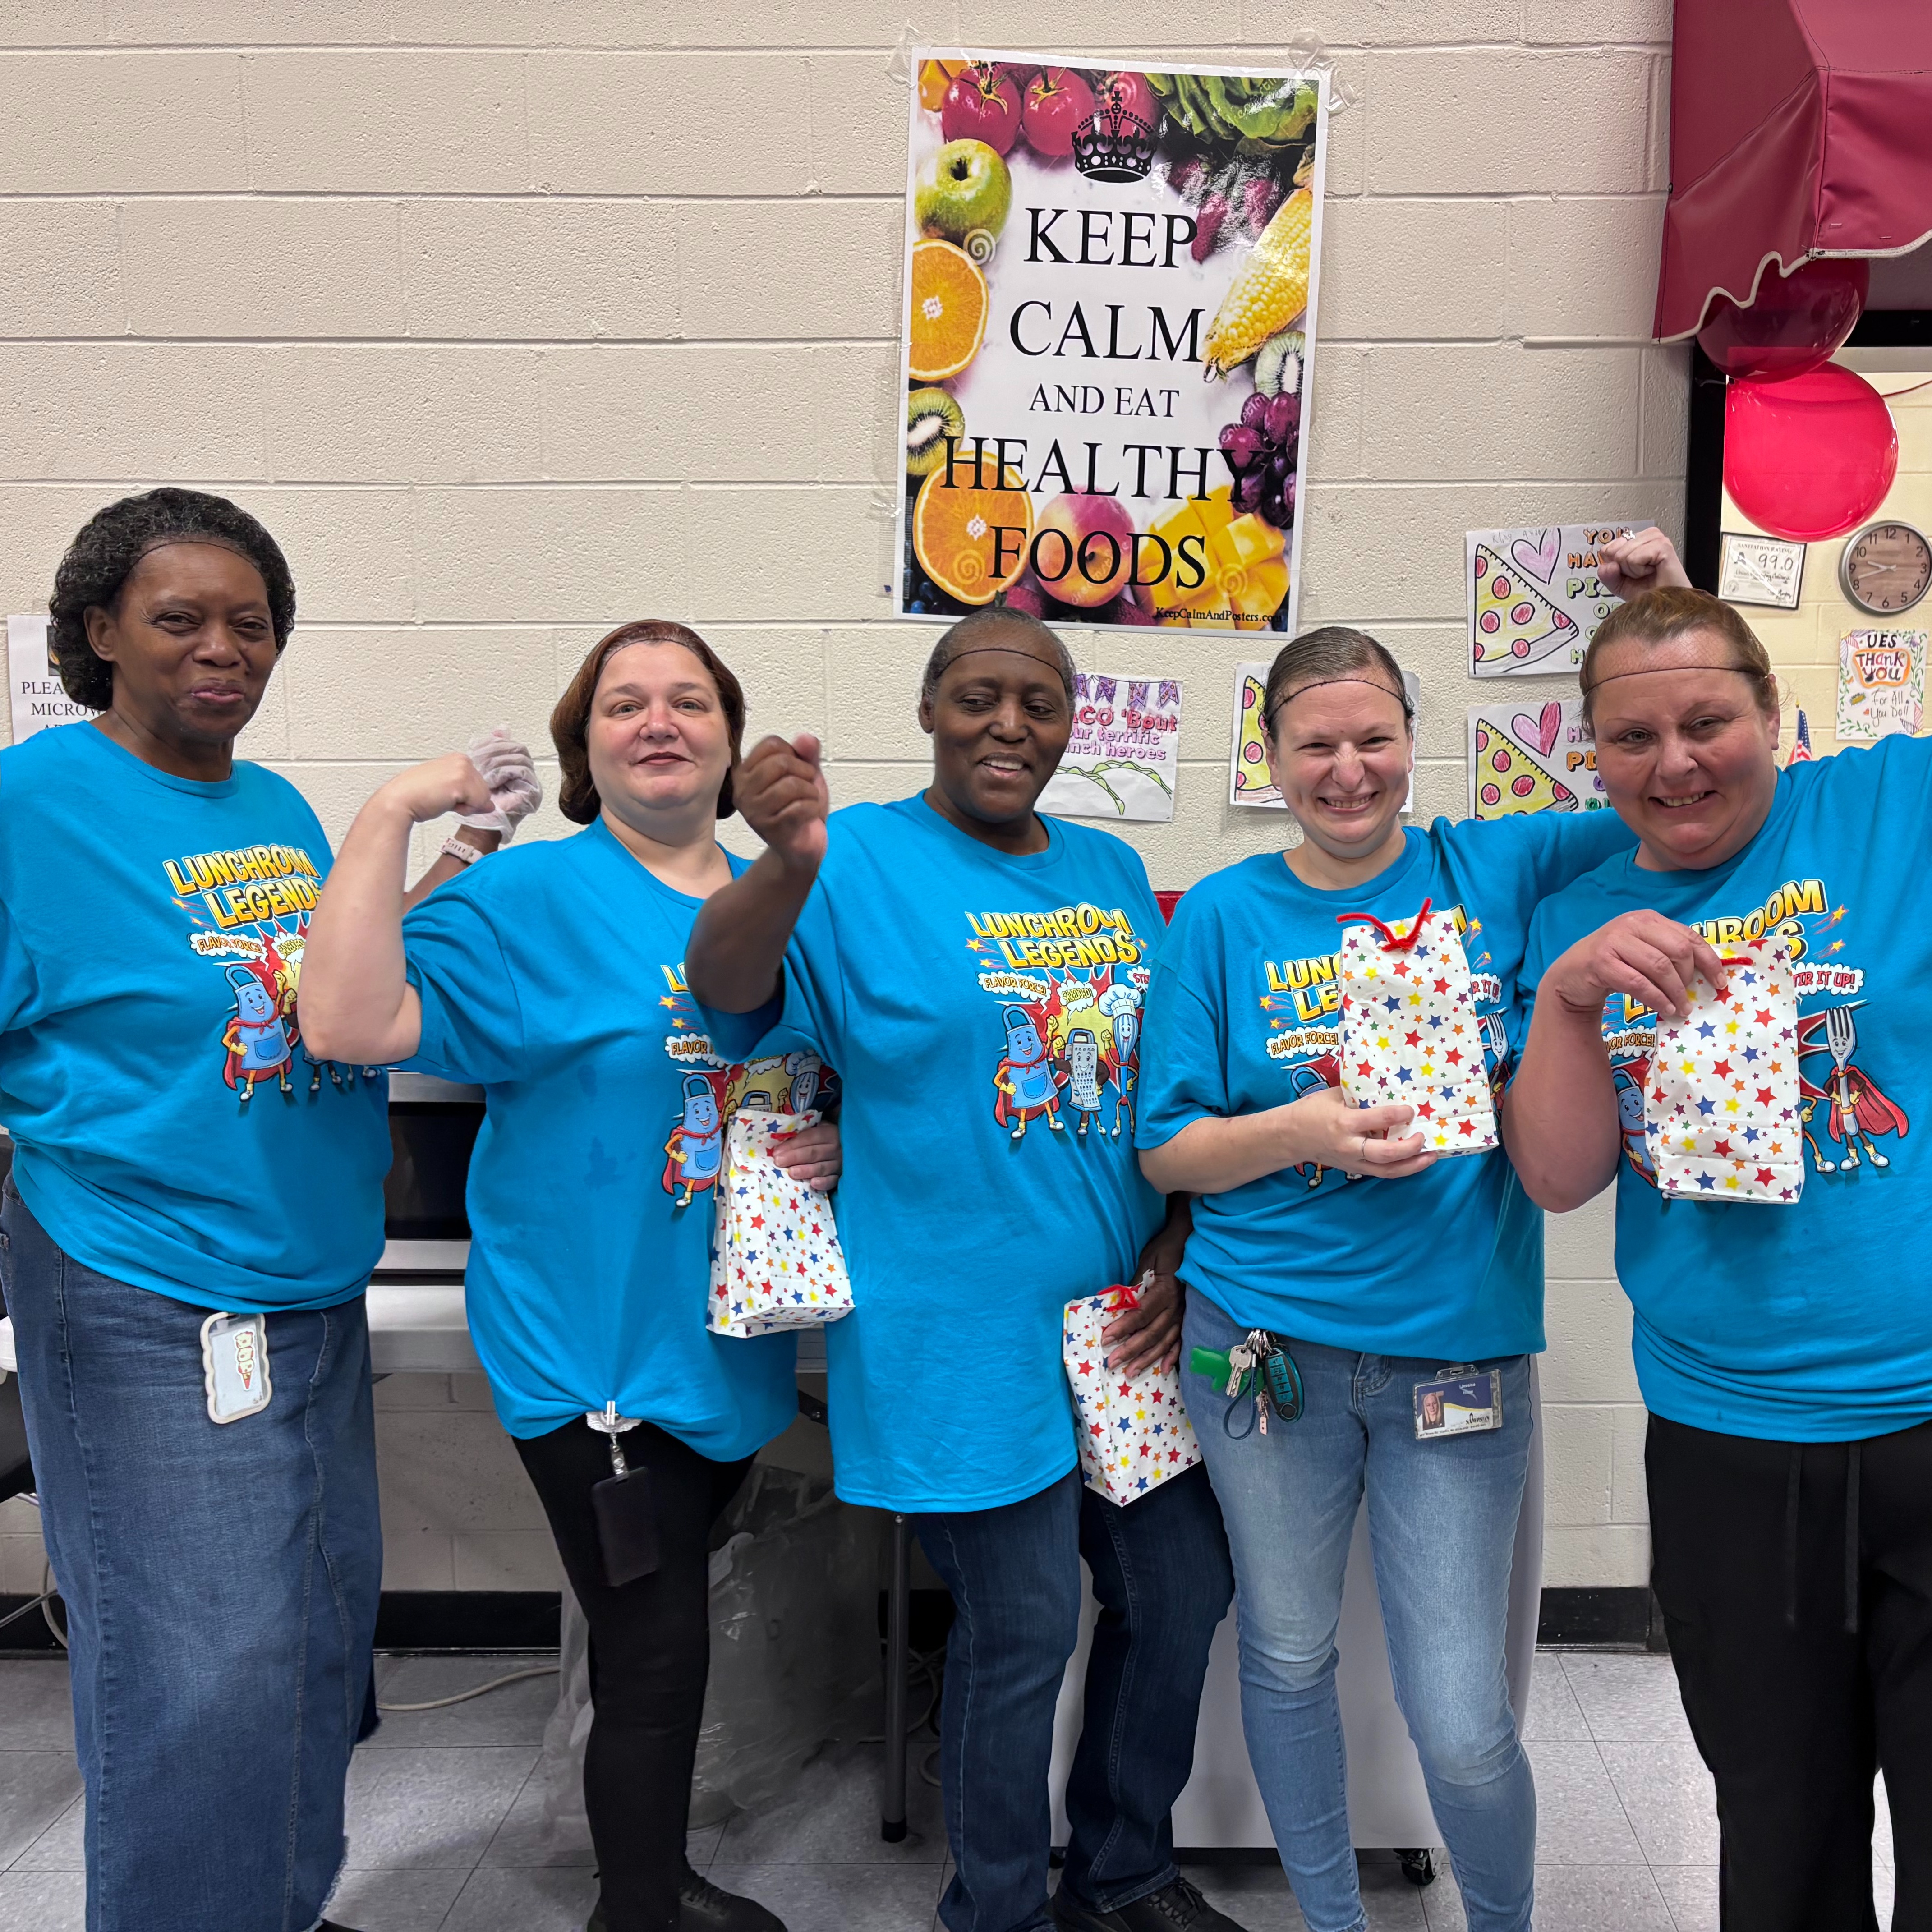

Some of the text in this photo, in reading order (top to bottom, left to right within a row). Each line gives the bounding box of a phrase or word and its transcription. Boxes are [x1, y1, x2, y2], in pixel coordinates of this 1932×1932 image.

[1023, 207, 1198, 269] KEEP
[1010, 300, 1206, 363] CALM
[1029, 383, 1180, 418] AND EAT
[939, 435, 1265, 503] HEALTHY
[1868, 533, 1877, 545] 11
[1884, 528, 1896, 539] 12
[1905, 533, 1909, 544] 1
[989, 525, 1206, 589] FOODS
[1855, 546, 1867, 558] 10
[1915, 546, 1923, 557] 2
[1758, 553, 1794, 570] 99.0
[1849, 562, 1856, 574] 9
[1920, 562, 1927, 574] 3
[1852, 579, 1859, 591] 8
[1914, 579, 1921, 590] 4
[1866, 592, 1873, 603] 7
[1882, 596, 1889, 608] 6
[1900, 591, 1908, 603] 5
[1867, 634, 1898, 649] UES
[21, 681, 64, 695] PLEA
[31, 703, 101, 716] MICRO
[1097, 727, 1160, 745] terrific
[1063, 740, 1167, 760] nch heroes
[202, 876, 322, 930] LEGENDS
[1690, 879, 1828, 945] HROOM
[998, 929, 1141, 970] LEGENDS
[984, 975, 1047, 996] FLAVOR FORCE!
[1793, 971, 1855, 989] TIR IT UP!
[671, 1039, 708, 1056] FLAVOR
[1270, 1030, 1339, 1055] FLAVOR FORCE!
[1624, 1032, 1655, 1048] FORCE!
